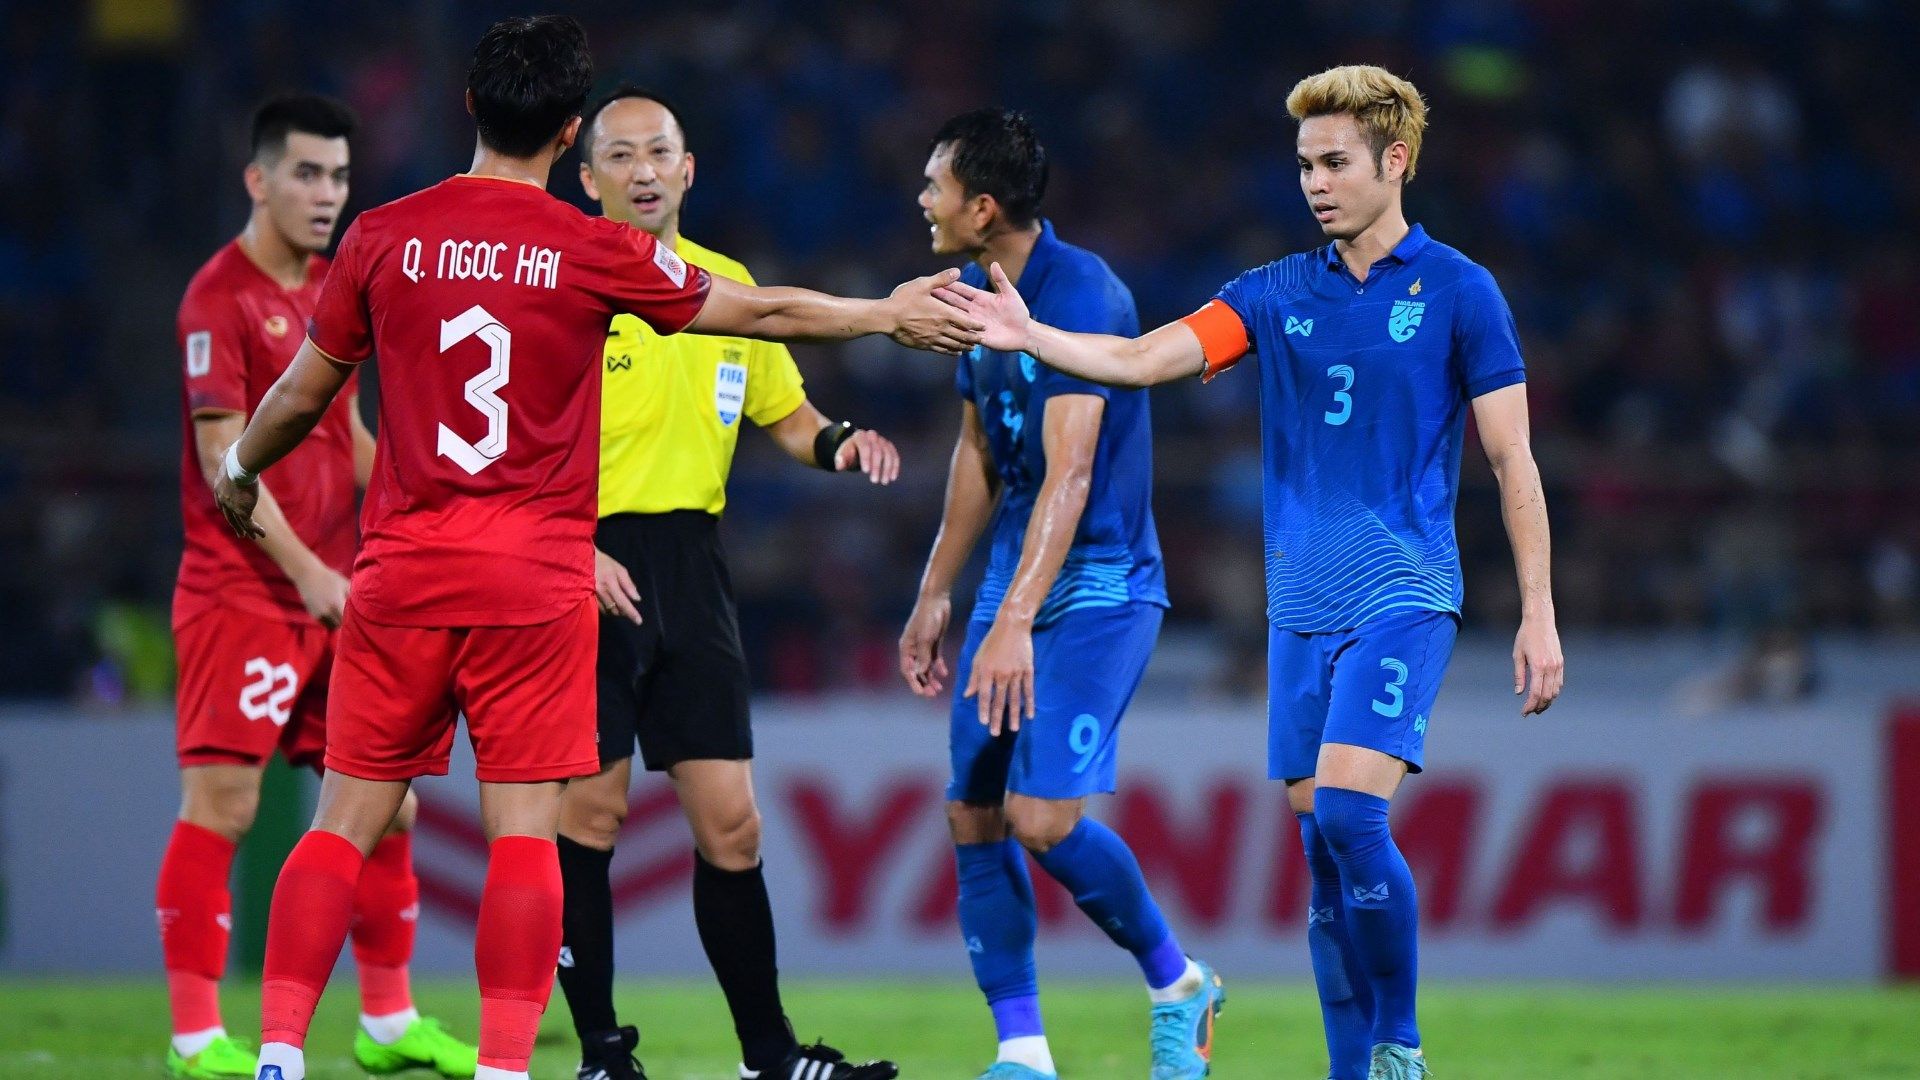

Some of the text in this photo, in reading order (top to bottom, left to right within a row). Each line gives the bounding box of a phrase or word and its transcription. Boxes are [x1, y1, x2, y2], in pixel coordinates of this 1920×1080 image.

[402, 237, 562, 290] Q. NGOC HAI
[436, 304, 512, 476] 3
[719, 367, 745, 384] FIFA
[1324, 364, 1355, 426] 3
[239, 656, 299, 727] 22
[1371, 657, 1409, 718] 3
[1068, 713, 1101, 774] 9
